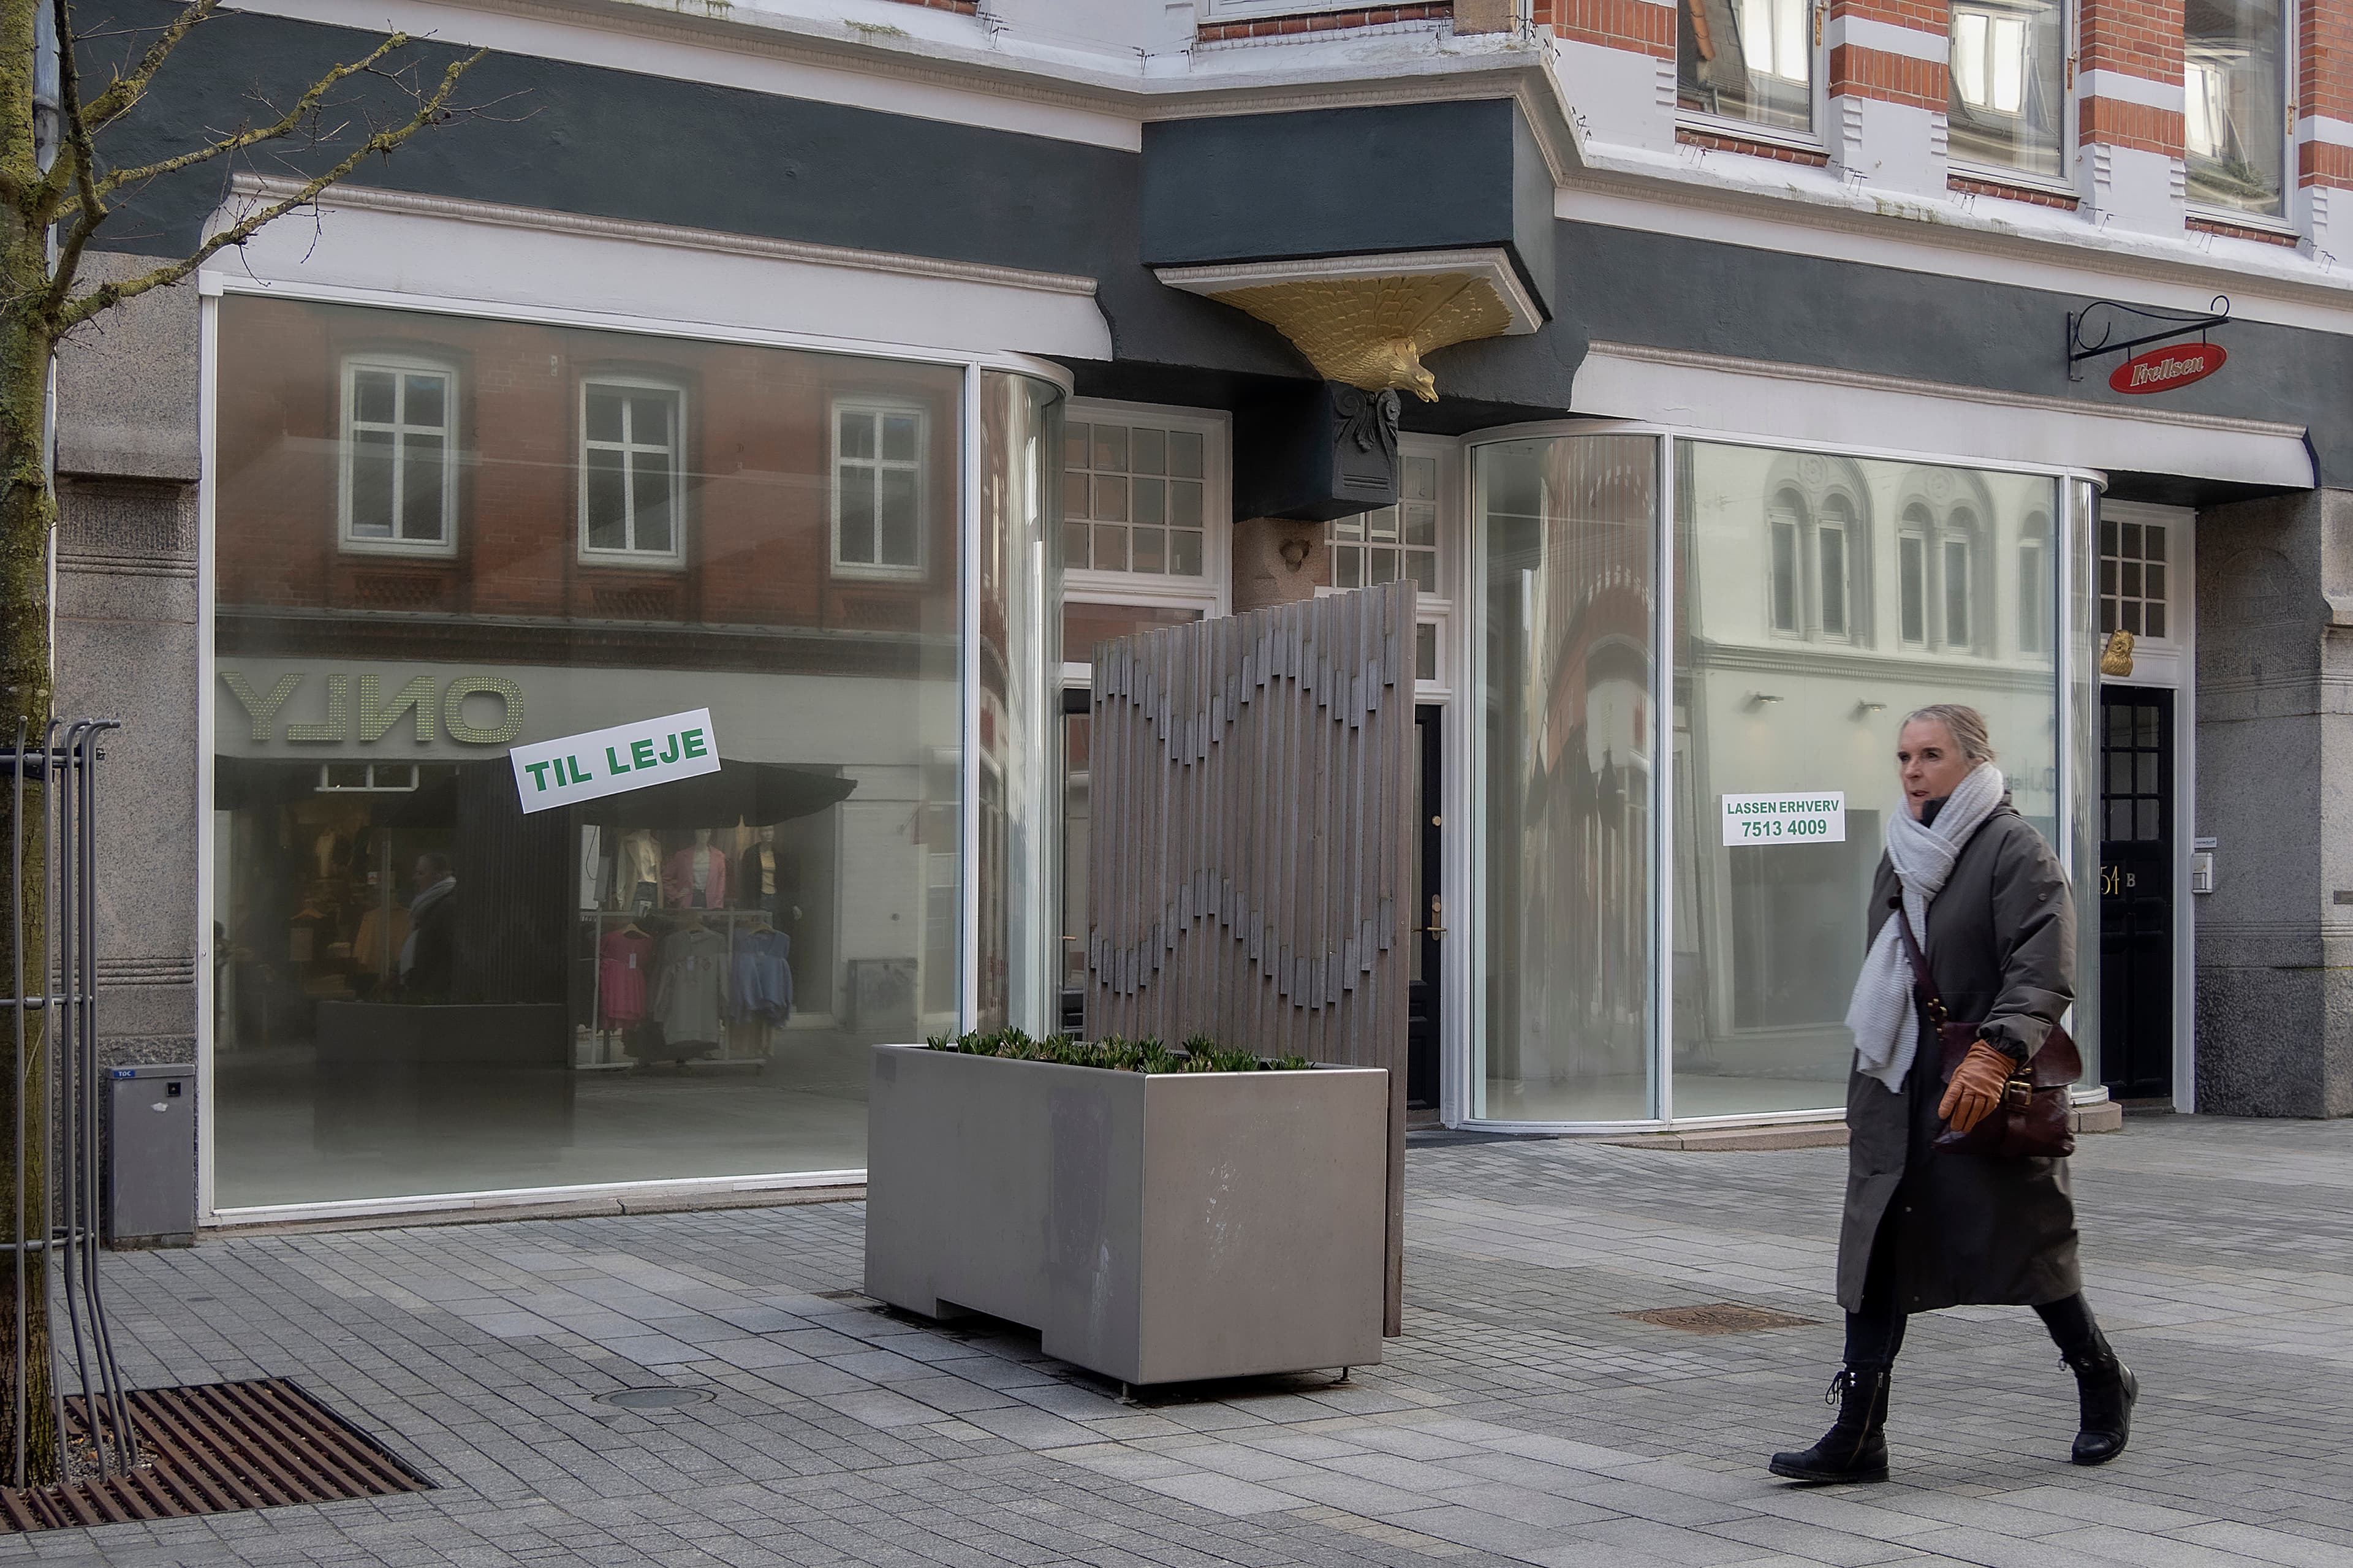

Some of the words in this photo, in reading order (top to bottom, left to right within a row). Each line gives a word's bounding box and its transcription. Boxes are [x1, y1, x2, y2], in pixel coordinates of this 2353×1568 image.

[2130, 357, 2204, 387] Frellsen
[525, 754, 593, 792] TIL
[605, 728, 708, 776] LEJE
[1727, 802, 1776, 814] LASSEN
[1779, 800, 1839, 813] ERHVERV
[1741, 820, 1782, 837] 7513
[1787, 819, 1827, 835] 4009
[2100, 865, 2120, 895] 54
[2126, 873, 2136, 887] B
